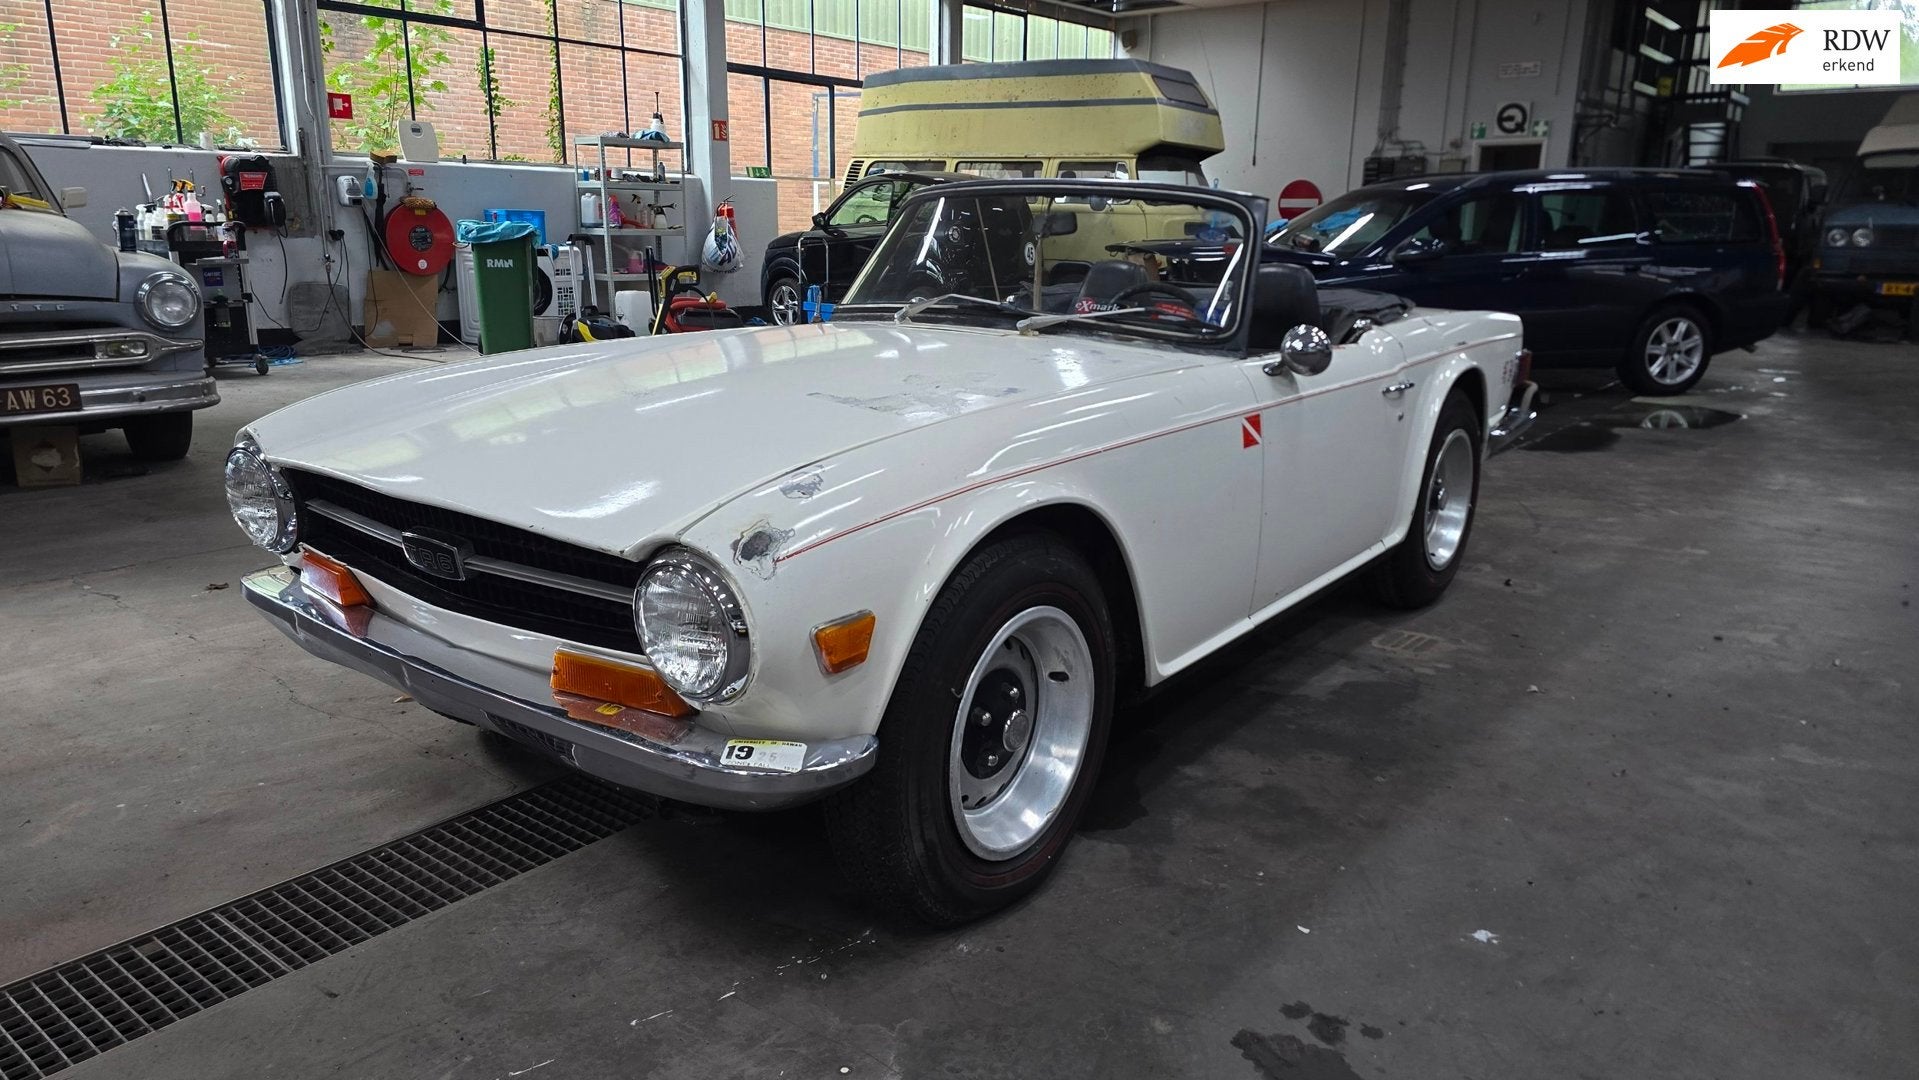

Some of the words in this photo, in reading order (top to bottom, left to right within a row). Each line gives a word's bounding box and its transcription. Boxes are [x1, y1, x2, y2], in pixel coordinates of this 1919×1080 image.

[7, 389, 36, 411] AW
[42, 387, 71, 408] 63
[404, 543, 455, 573] TR6
[725, 745, 755, 760] 19
